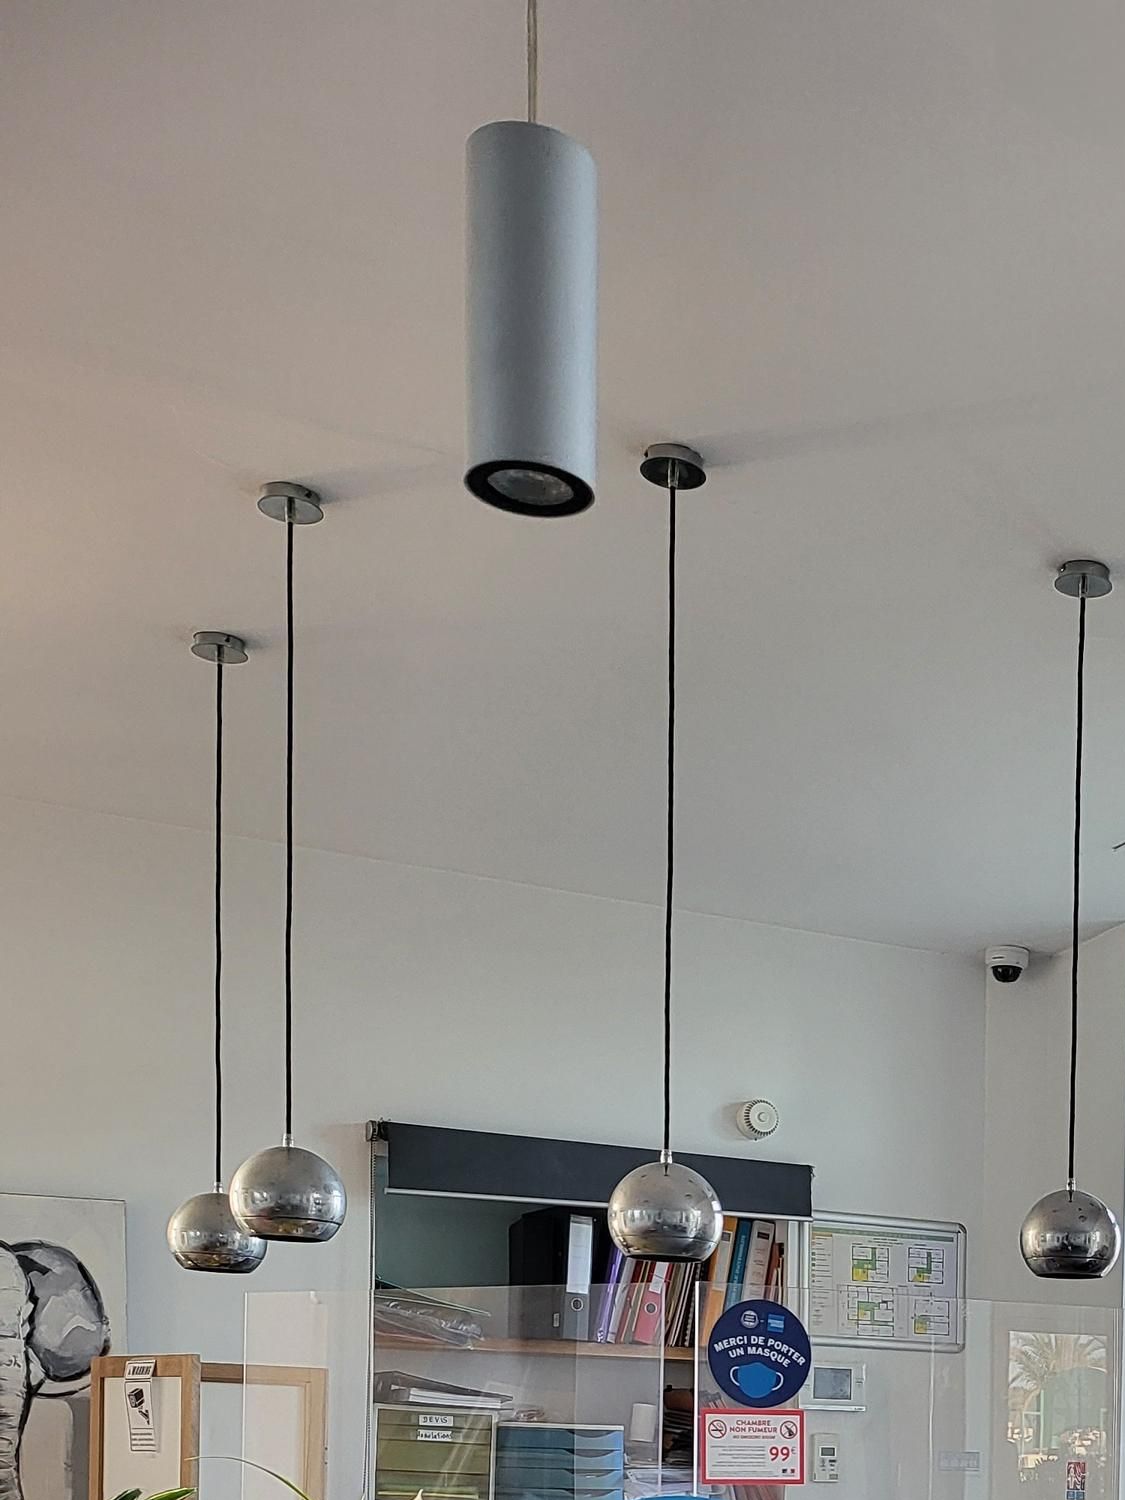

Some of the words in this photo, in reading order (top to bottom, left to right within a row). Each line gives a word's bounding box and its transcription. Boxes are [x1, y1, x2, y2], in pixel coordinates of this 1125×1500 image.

[714, 1335, 747, 1352] MERCI
[751, 1335, 765, 1345] DE
[767, 1338, 806, 1366] PORTER
[728, 1347, 744, 1358] UN
[747, 1346, 791, 1368] MASQUE
[423, 1416, 448, 1424] DEVIS
